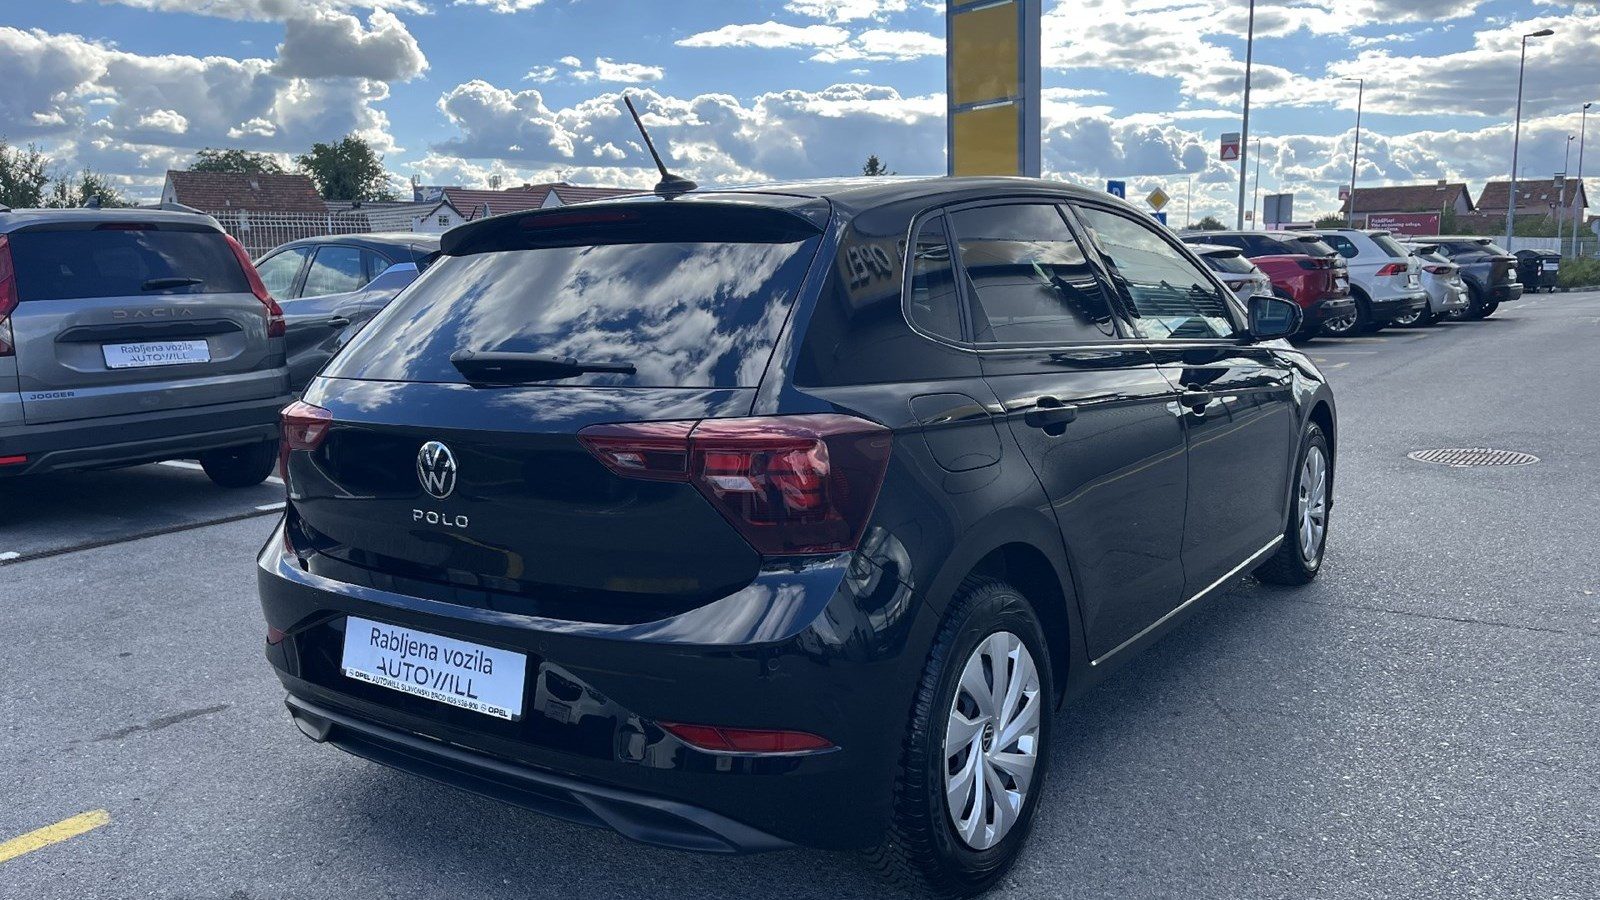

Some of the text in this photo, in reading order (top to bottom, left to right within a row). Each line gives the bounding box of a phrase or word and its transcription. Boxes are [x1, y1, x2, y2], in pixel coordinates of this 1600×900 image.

[112, 307, 193, 319] DACIA
[120, 342, 193, 354] Rabljena vozila
[30, 391, 75, 400] JOGGER
[412, 508, 469, 529] POLO
[369, 627, 493, 675] Rabljena vozila
[354, 671, 371, 681] OPEL
[372, 675, 400, 689] AUTOWILL
[401, 683, 430, 697] SLAVONSKI
[431, 691, 447, 702] BROD
[488, 706, 508, 718] OPEL
